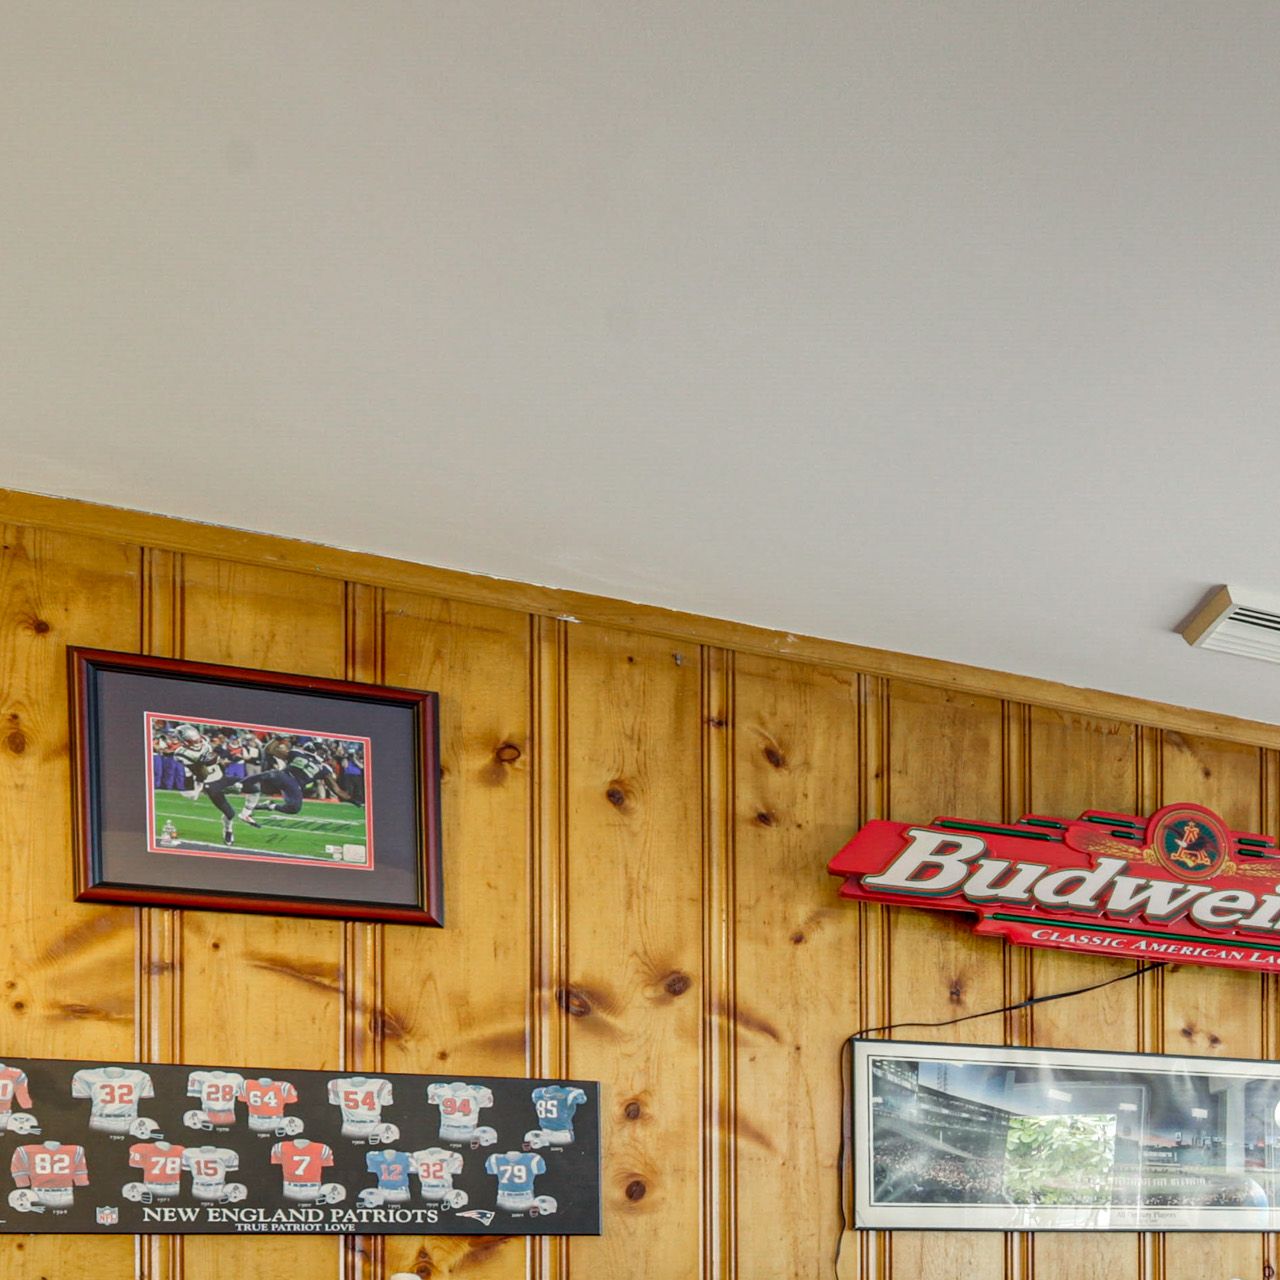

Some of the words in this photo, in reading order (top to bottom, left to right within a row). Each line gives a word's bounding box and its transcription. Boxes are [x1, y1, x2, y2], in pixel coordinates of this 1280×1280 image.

[100, 1083, 134, 1104] 32
[206, 1083, 234, 1102] 28
[249, 1090, 278, 1108] 64
[343, 1091, 376, 1111] 54
[441, 1097, 472, 1117] 94
[34, 1153, 70, 1176] 82
[151, 1156, 181, 1175] 78
[194, 1159, 218, 1177] 15
[292, 1155, 311, 1176] 7
[380, 1164, 403, 1181] 12
[420, 1162, 444, 1180] 32
[500, 1164, 528, 1183] 79
[143, 1207, 200, 1222] NEW
[207, 1207, 324, 1223] ENGLAND
[330, 1208, 438, 1224] PATRIOTS
[235, 1223, 267, 1232] TRUE
[270, 1223, 321, 1232] PATRIOT
[325, 1223, 356, 1232] LOVE
